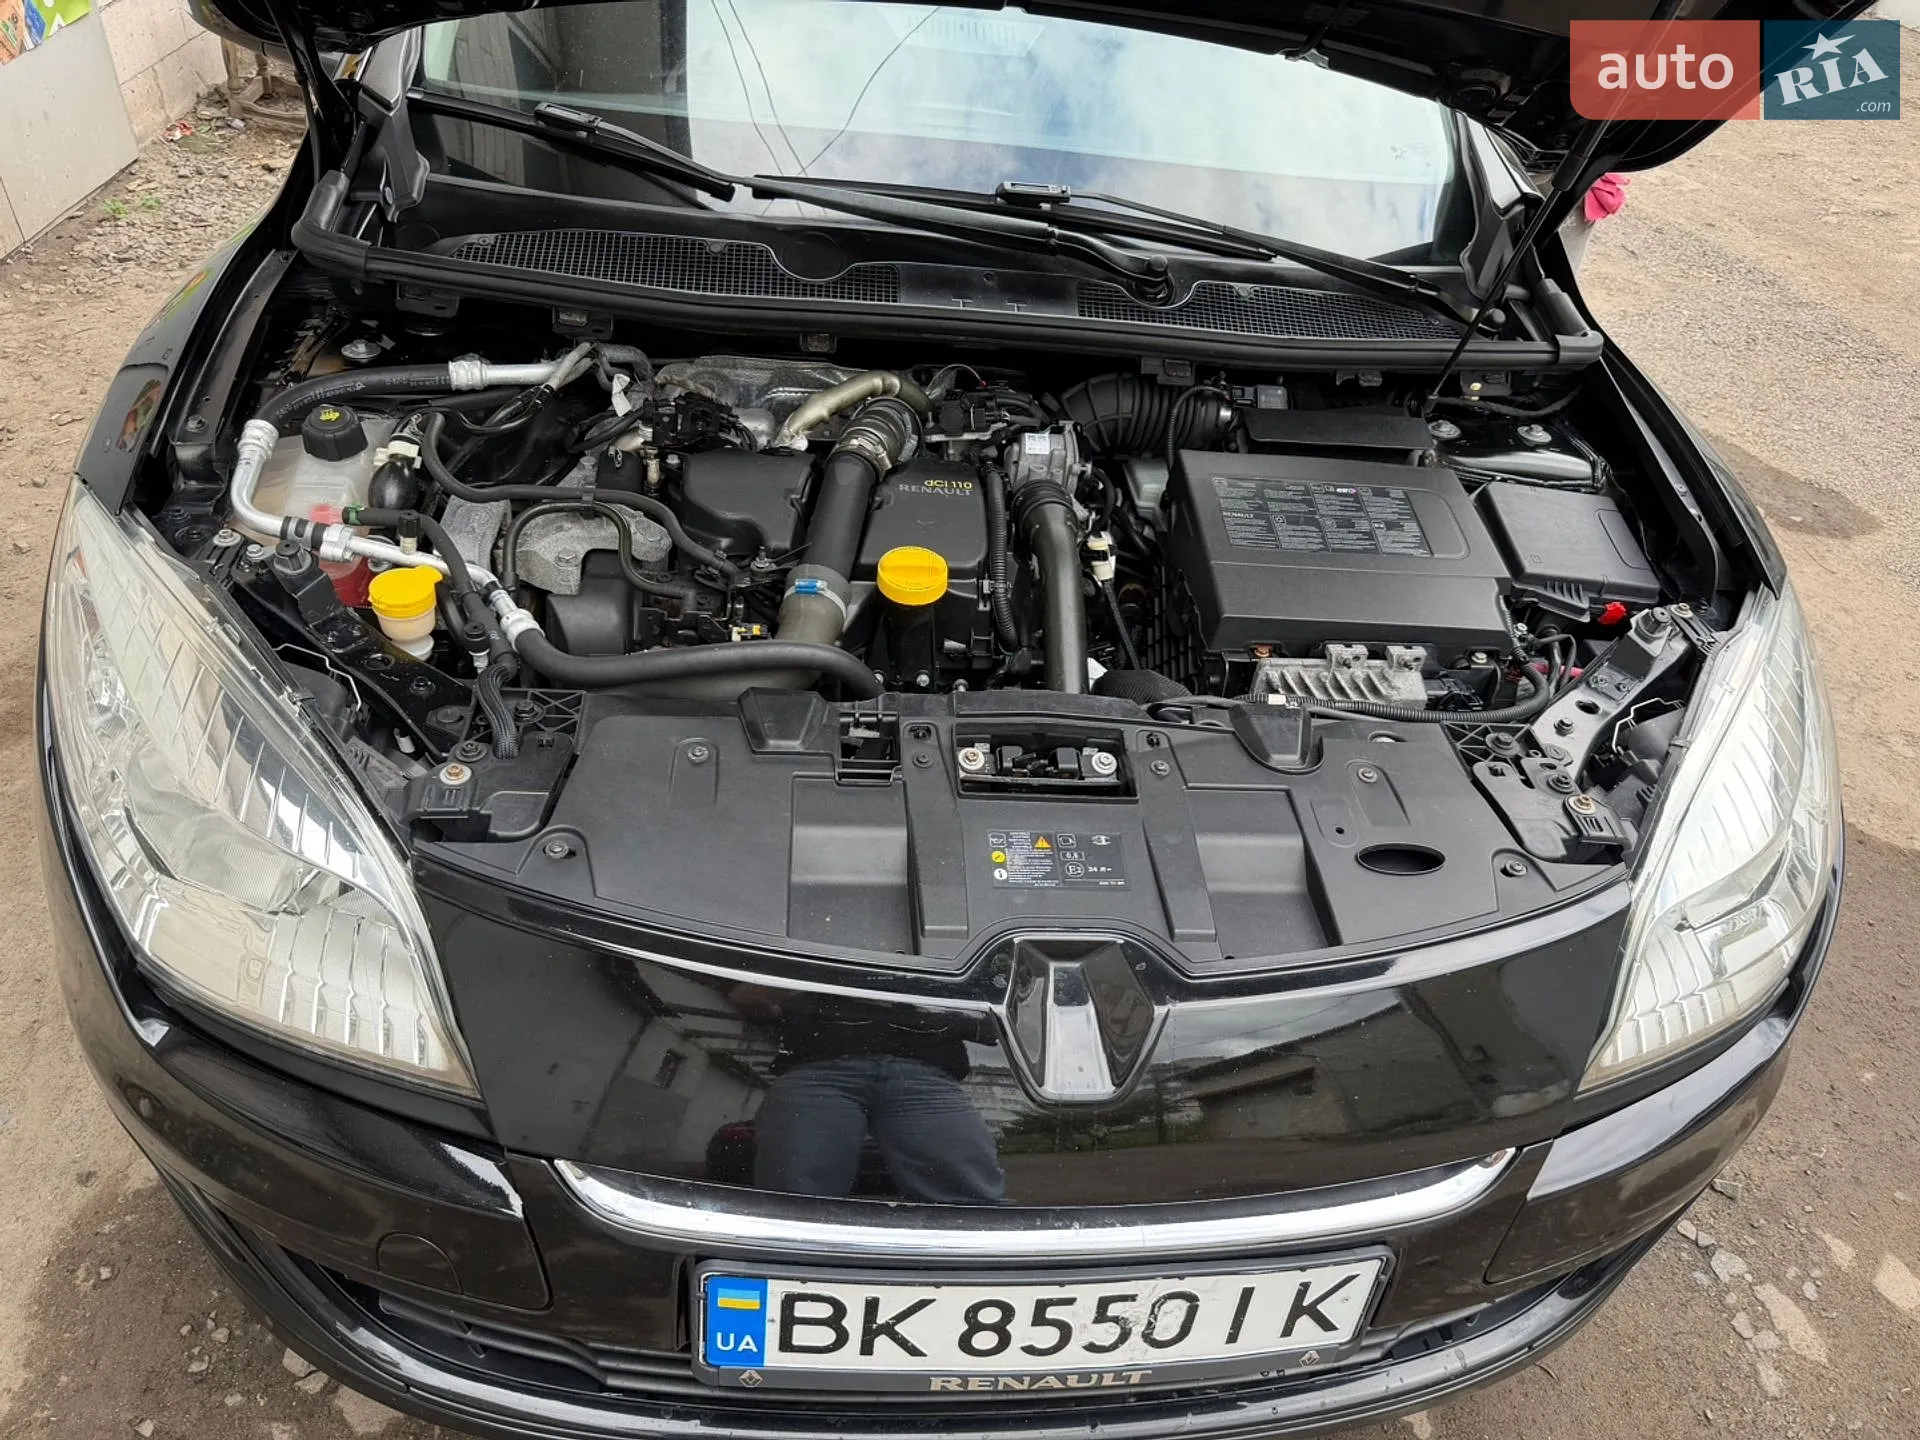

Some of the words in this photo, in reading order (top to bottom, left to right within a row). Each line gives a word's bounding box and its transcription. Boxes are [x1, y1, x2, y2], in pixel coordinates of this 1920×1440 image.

[899, 484, 973, 496] RENAULT
[951, 481, 972, 489] 110
[779, 1291, 937, 1357] BK
[957, 1290, 1201, 1357] 8550
[1225, 1273, 1362, 1345] IK
[716, 1332, 758, 1352] UA
[929, 1370, 1153, 1391] RENAULT
